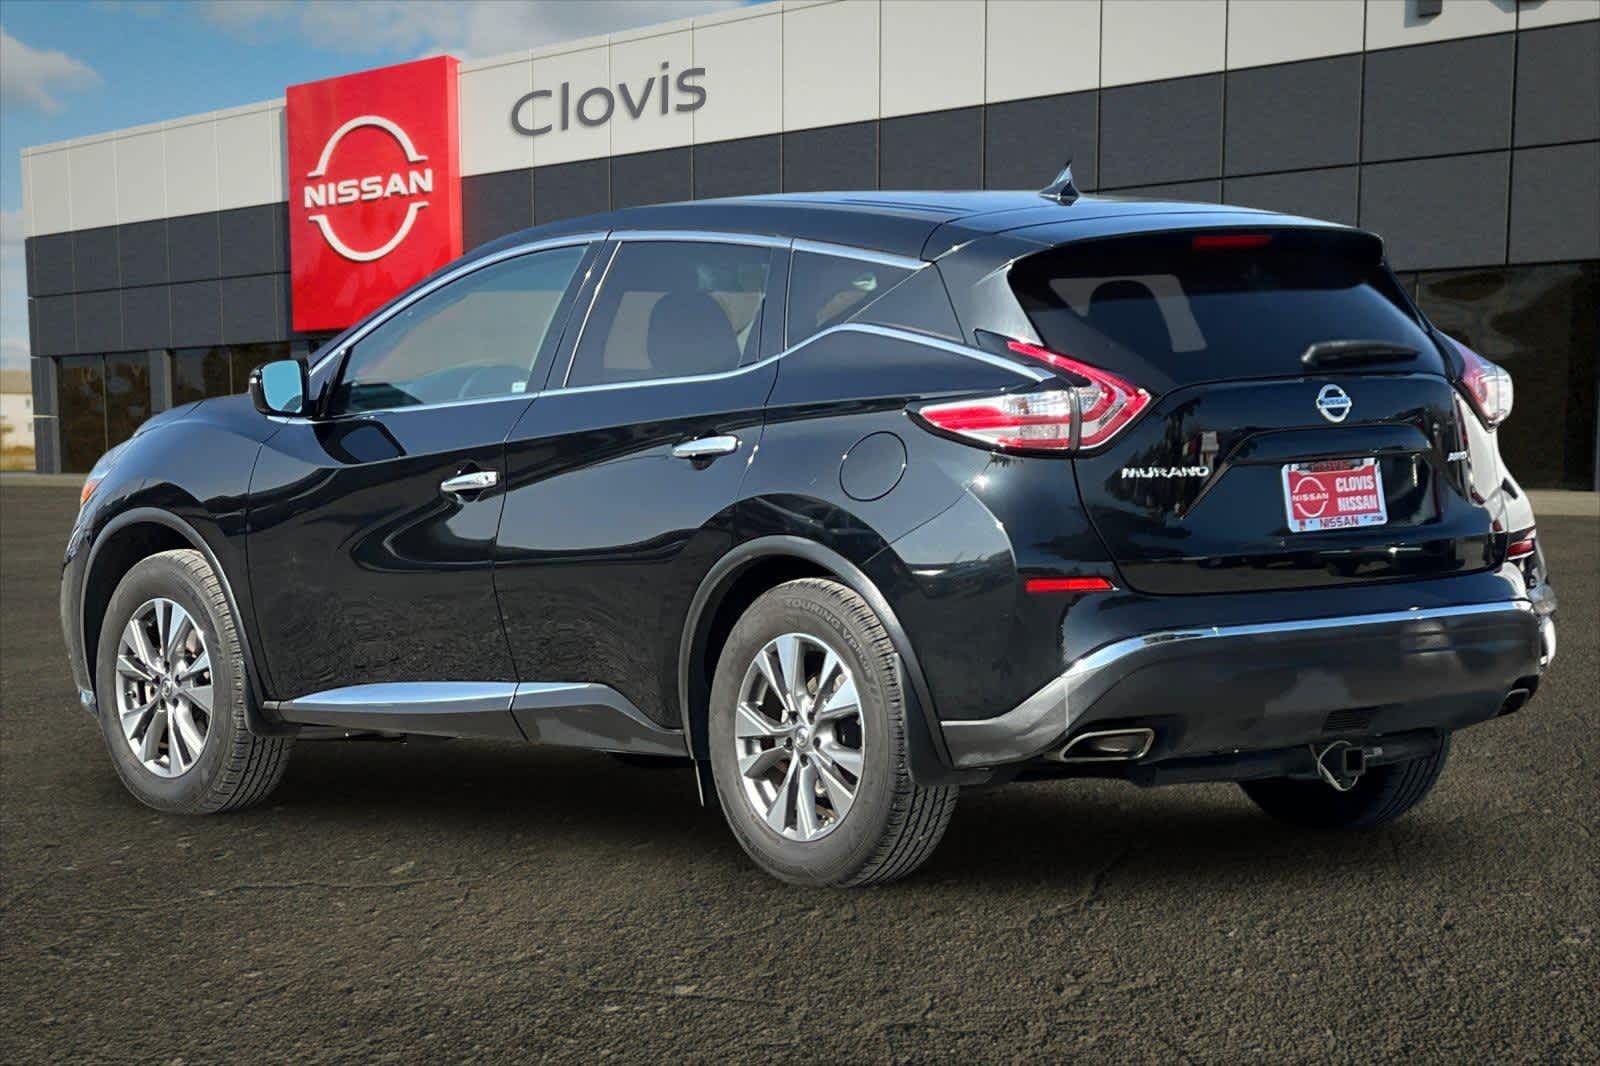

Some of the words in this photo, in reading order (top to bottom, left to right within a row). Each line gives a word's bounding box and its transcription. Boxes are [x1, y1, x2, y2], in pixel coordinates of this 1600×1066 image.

[511, 61, 707, 136] Clovis
[304, 168, 433, 208] NISSAN
[1121, 466, 1209, 479] MURANO
[1335, 474, 1375, 493] CLOVIS
[1292, 492, 1329, 502] NISSAN
[1337, 494, 1378, 512] NISSAN
[1320, 515, 1359, 529] NISSAN
